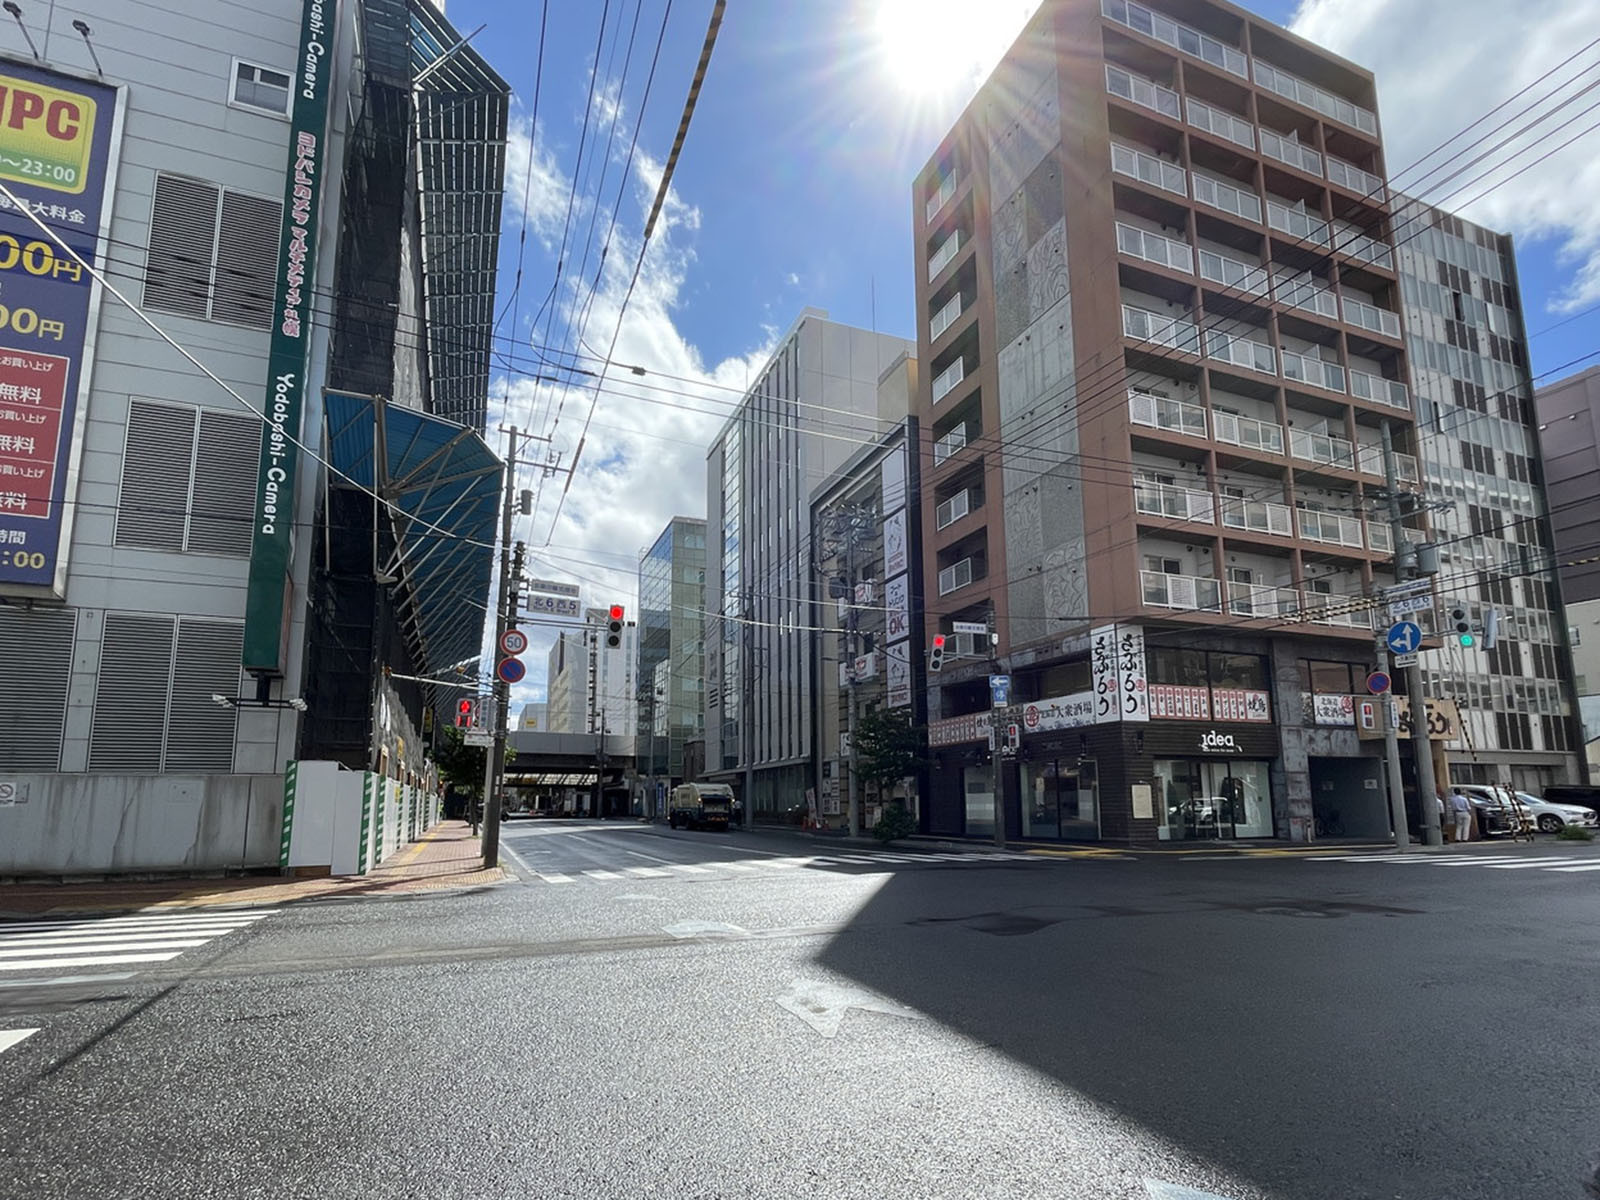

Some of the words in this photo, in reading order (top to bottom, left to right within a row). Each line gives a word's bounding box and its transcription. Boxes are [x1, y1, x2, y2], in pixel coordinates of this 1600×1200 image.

[303, 0, 326, 99] ashi-Camera
[0, 155, 76, 182] ～23:00
[0, 356, 54, 372] お買い上げ
[0, 383, 41, 405] 無料
[262, 373, 295, 534] Yodobashi-Camera
[0, 464, 45, 478] 買い上げ
[0, 491, 27, 510] 料
[890, 614, 905, 635] OK
[506, 636, 522, 649] 50
[1201, 730, 1235, 746] idea
